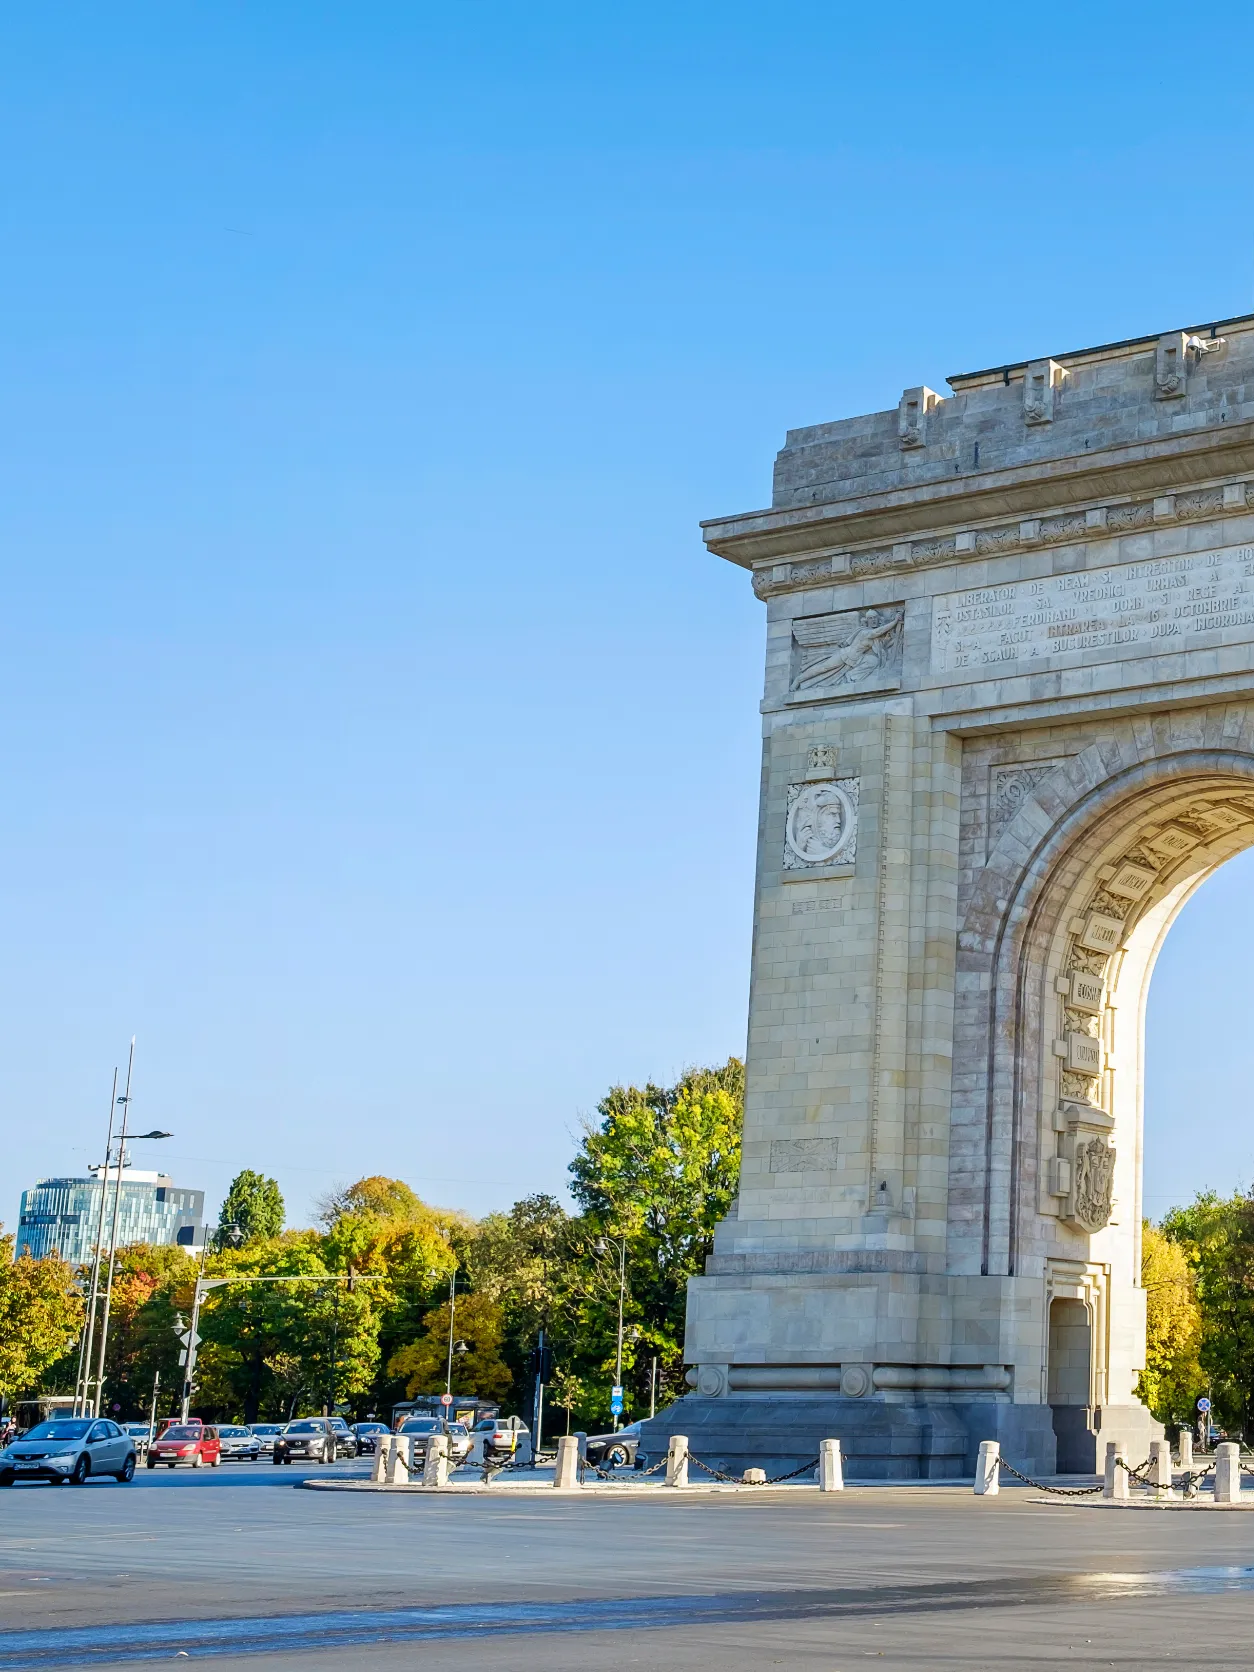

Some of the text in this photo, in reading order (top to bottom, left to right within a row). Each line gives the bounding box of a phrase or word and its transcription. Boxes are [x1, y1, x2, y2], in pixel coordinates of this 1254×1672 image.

[956, 587, 1017, 608] LIBERATOR
[1030, 584, 1044, 596] DE
[1058, 575, 1090, 591] NEAM
[1101, 572, 1113, 584] SI
[1126, 558, 1193, 581] INTREGITOR
[1207, 554, 1222, 568] DE
[956, 604, 1015, 622] OSTASILOR
[1073, 585, 1125, 604] VREDNICI
[999, 631, 1034, 647] FACUT
[1048, 620, 1106, 639] INTRAREA
[1119, 615, 1135, 628] LA
[1148, 611, 1160, 624] 16
[1174, 598, 1239, 619] OCTOMBRIE
[1014, 608, 1077, 630] FERDINAND
[1113, 598, 1145, 613] DOMN
[1163, 593, 1172, 605] SI
[1188, 585, 1217, 601] REGE
[1234, 582, 1250, 594] AL
[955, 655, 969, 668] DE
[982, 647, 1019, 664] SCAUN
[1031, 647, 1039, 657] A
[1053, 629, 1138, 654] BUCURESTILOR
[1151, 623, 1182, 639] DUPA
